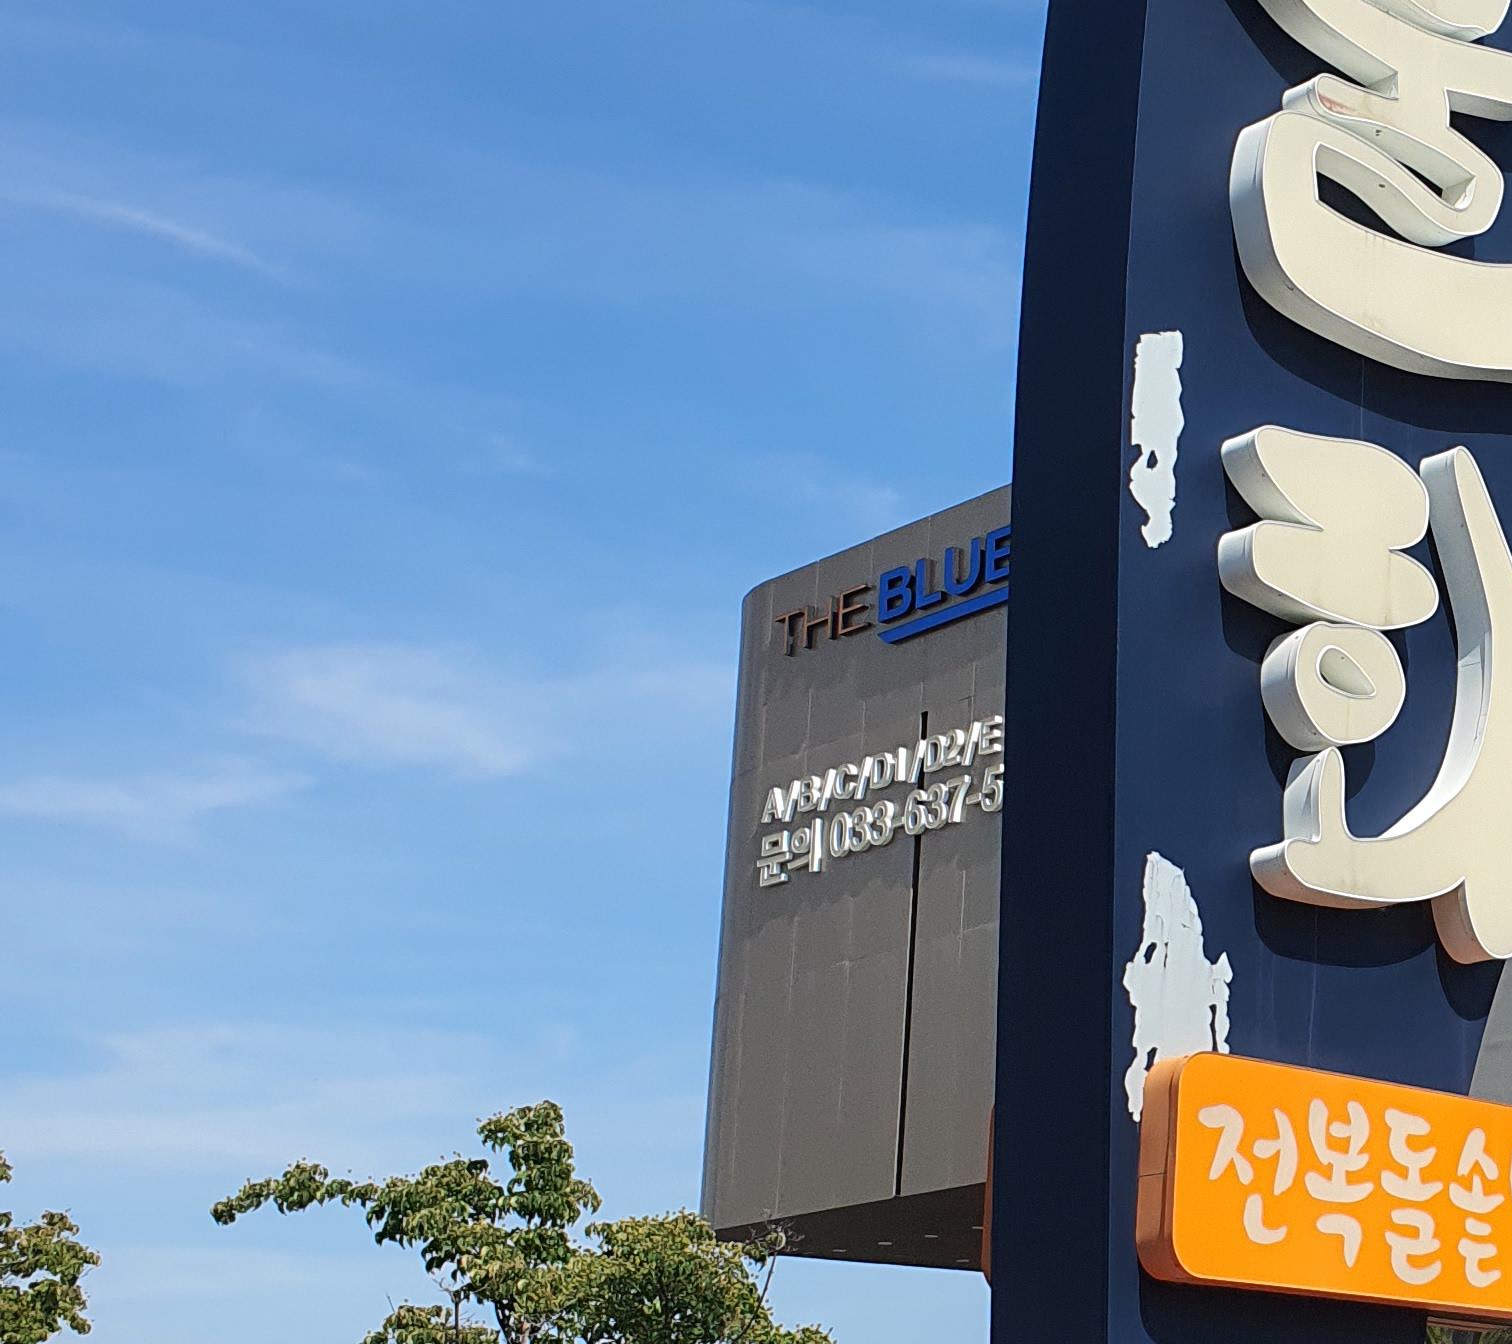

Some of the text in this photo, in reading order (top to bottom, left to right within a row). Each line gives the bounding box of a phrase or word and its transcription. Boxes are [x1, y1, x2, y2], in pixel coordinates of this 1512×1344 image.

[775, 526, 1011, 656] THE BLUE
[757, 817, 826, 888] 문의
